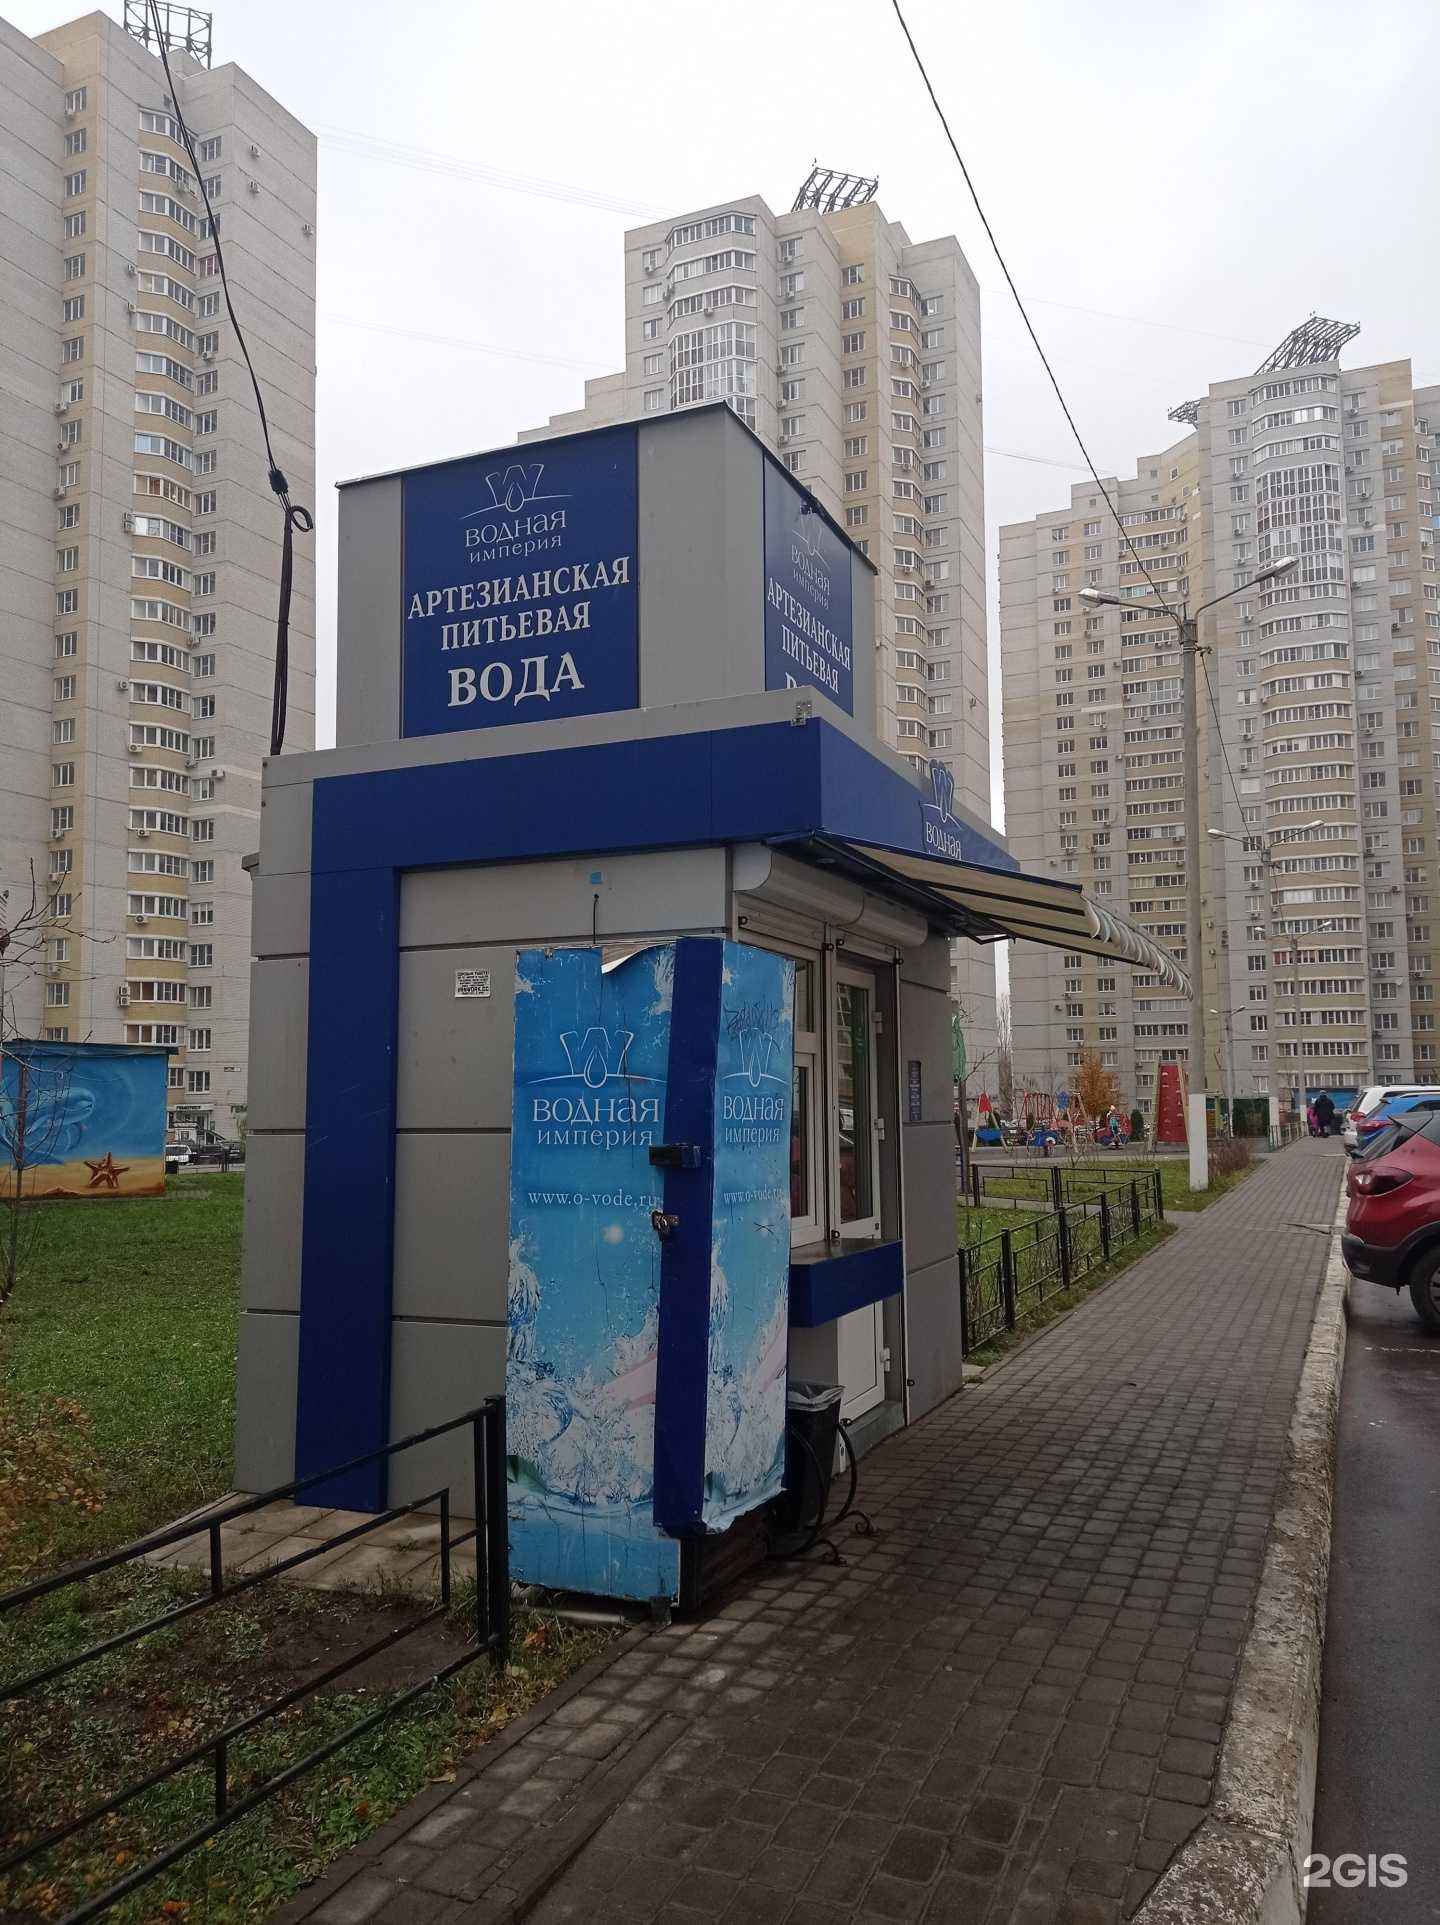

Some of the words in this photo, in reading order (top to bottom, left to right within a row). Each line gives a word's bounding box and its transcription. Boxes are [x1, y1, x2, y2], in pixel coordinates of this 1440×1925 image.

[408, 556, 630, 619] АРТЕЗИАНСКАЯ
[441, 601, 591, 651] ПИТЬЕВАЯ
[767, 577, 852, 671] АРТЕЗИАНСКАЯ
[448, 651, 585, 707] ВОДА
[781, 624, 839, 694] ПИТЬЕВАЯ
[537, 1129, 653, 1150] империя
